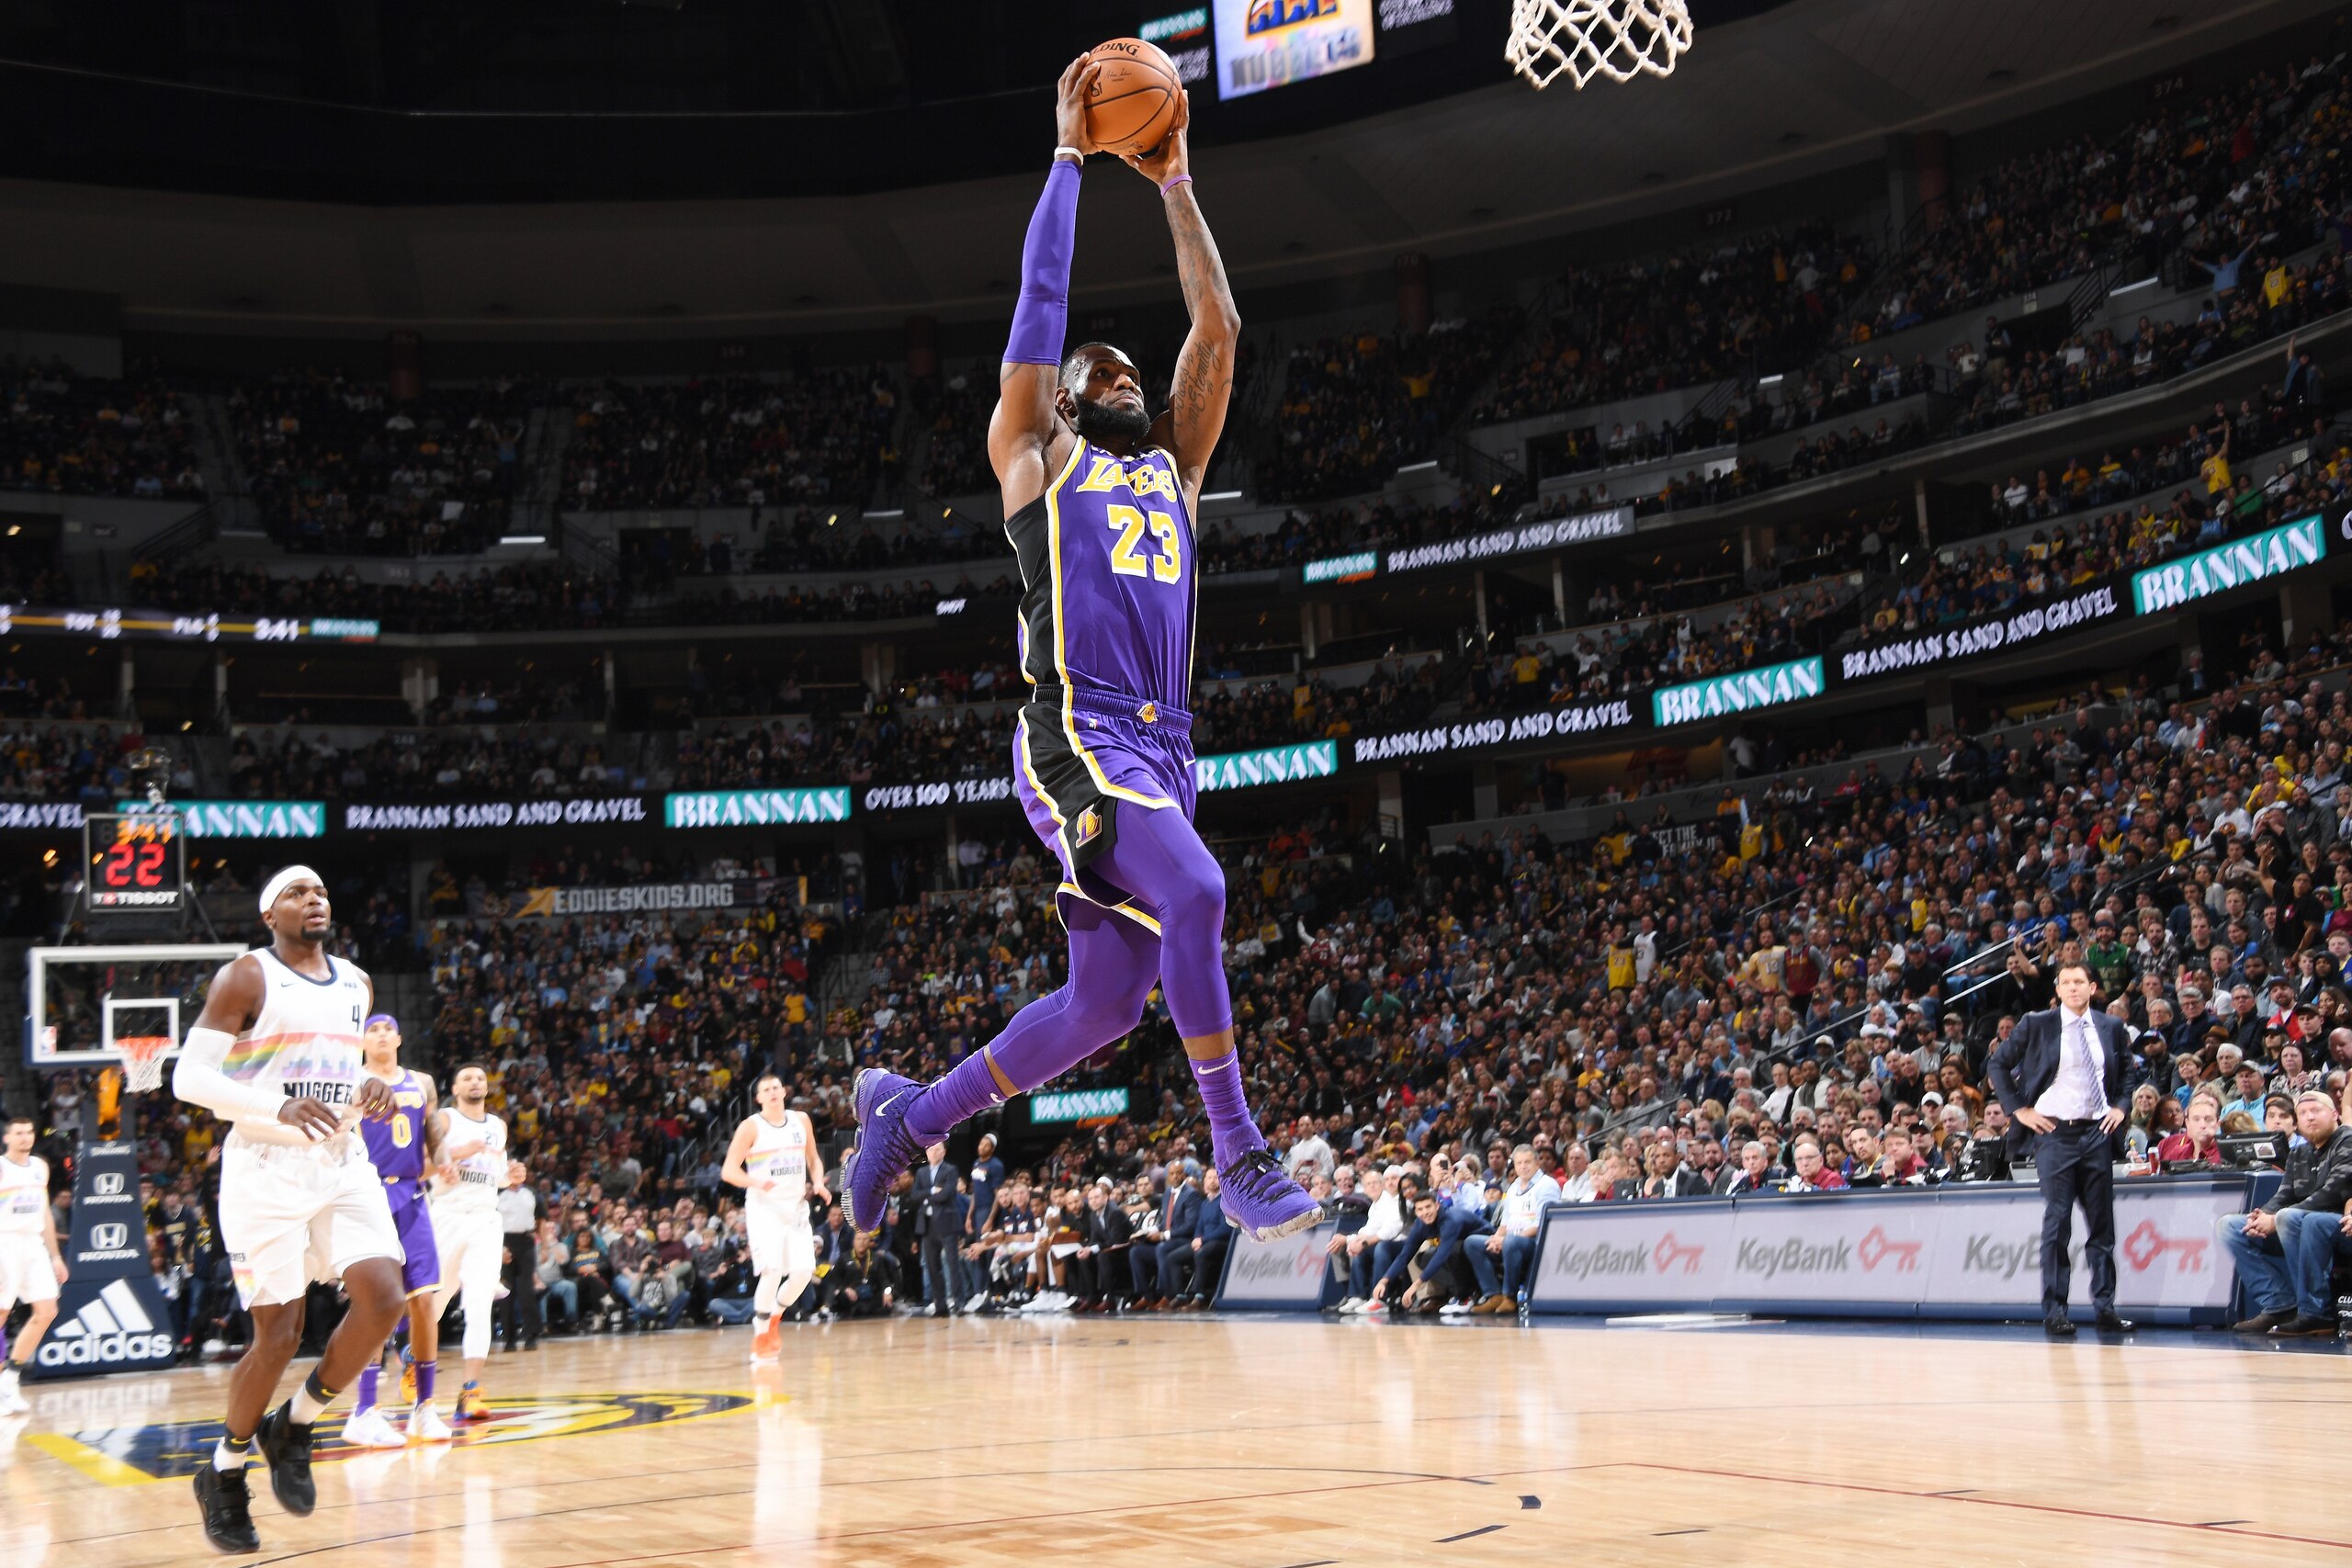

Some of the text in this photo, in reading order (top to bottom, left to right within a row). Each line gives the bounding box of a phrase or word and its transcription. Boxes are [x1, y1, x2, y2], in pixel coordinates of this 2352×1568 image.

[1106, 504, 1182, 585] 23
[1468, 531, 1514, 558] SAND
[1516, 524, 1555, 551] AND
[1555, 511, 1623, 543] GRAVEL
[2141, 521, 2317, 614] BRANNAN
[1842, 586, 2118, 680] BRANNAN SAND AND GRAVEL
[1660, 660, 1818, 725] BRANNAN
[1354, 700, 1633, 762] BRANNAN SAND AND GRAVEL
[1196, 742, 1331, 792] RANNAN
[346, 797, 647, 829] BRANNAN SAND AND GRAVEL
[674, 790, 844, 828] BRANNAN
[865, 787, 915, 810] OVER
[954, 777, 1011, 803] YEARS
[106, 843, 165, 886] 22
[118, 891, 178, 904] TISSOT
[555, 883, 733, 914] EDDIESKIDS.ORG
[352, 1004, 360, 1032] 4
[391, 1112, 413, 1149] 0
[1556, 1240, 1649, 1280] KeyBank
[1736, 1236, 1851, 1280] KeyBank
[39, 1330, 173, 1367] adidas
